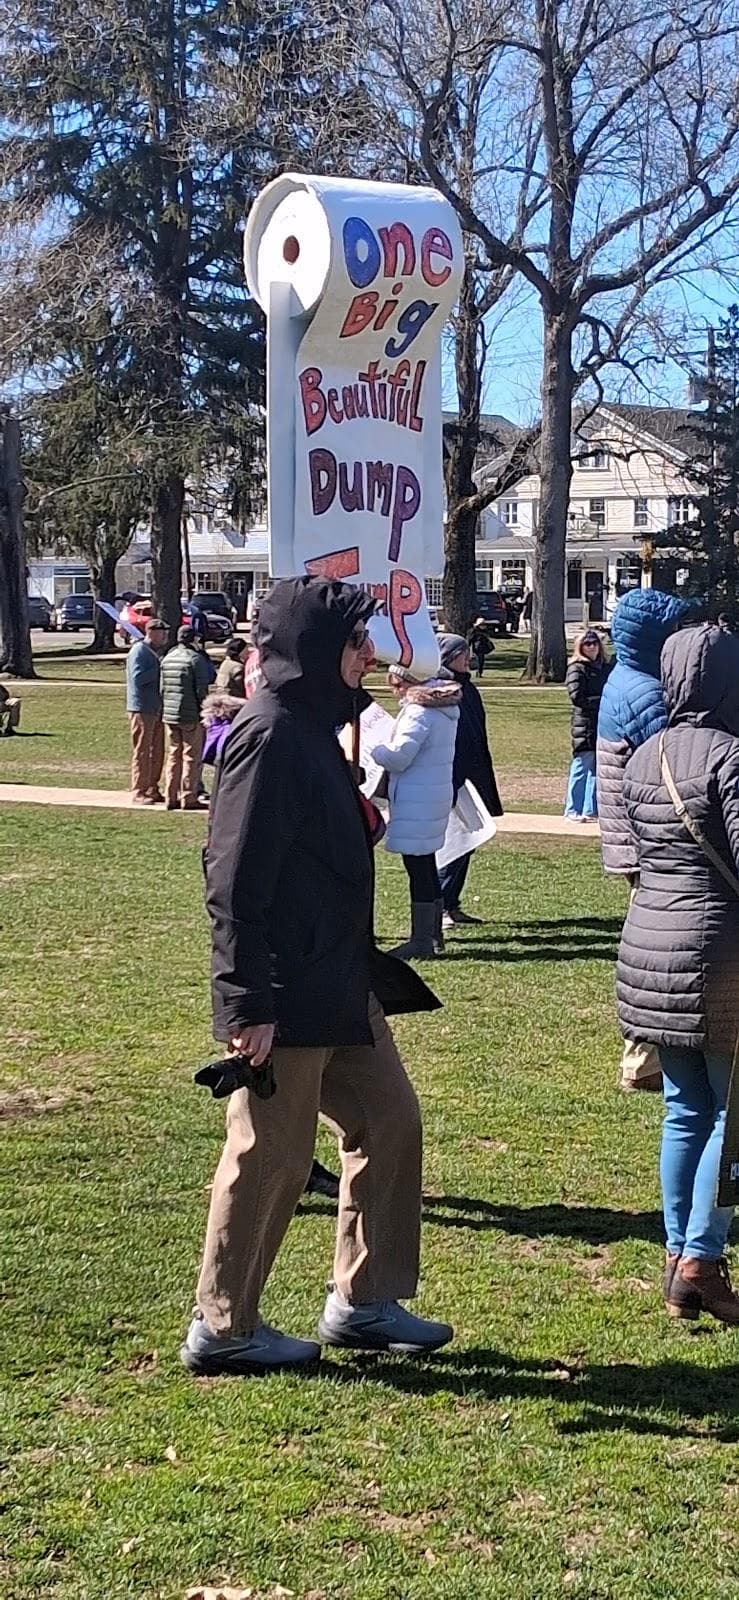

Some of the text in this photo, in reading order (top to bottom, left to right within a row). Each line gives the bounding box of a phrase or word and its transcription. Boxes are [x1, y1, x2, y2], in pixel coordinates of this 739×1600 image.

[343, 217, 453, 288] One
[339, 282, 440, 358] Big
[309, 448, 421, 562] Dump
